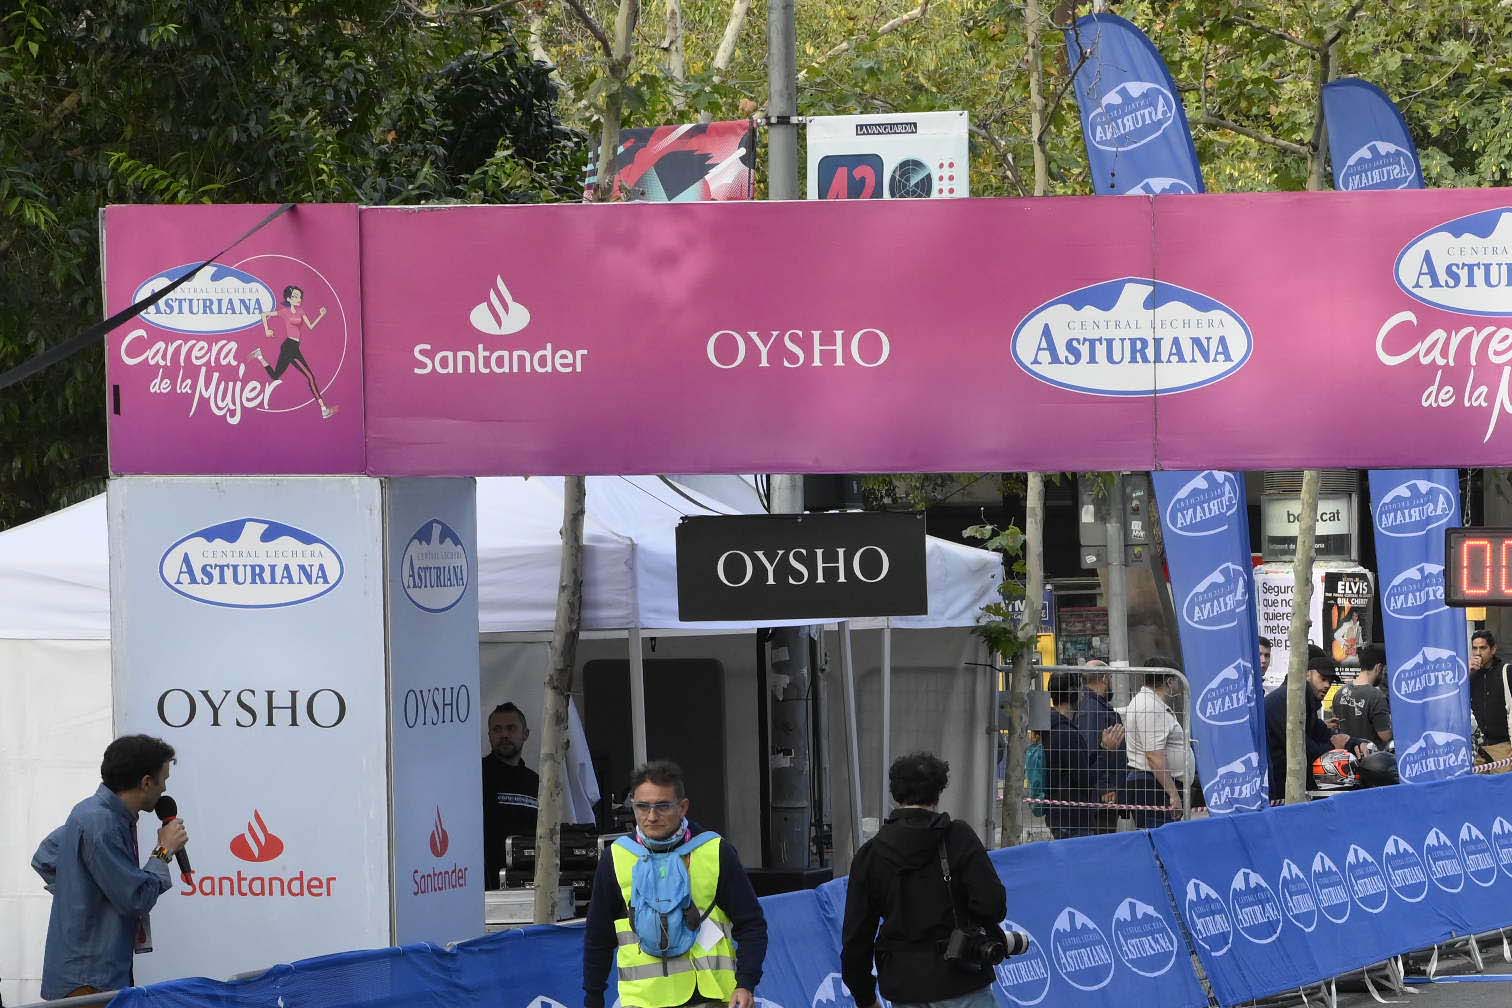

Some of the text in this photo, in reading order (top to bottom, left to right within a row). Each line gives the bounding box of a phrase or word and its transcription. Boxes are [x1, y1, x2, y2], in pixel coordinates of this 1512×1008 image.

[143, 288, 264, 316] ASTURIANA
[214, 287, 260, 295] LECHERA
[1067, 319, 1226, 330] CENTRAL LECHERA
[121, 329, 237, 367] Carrera
[413, 342, 588, 374] Santander
[706, 328, 891, 369] OYSHO
[1030, 323, 1233, 366] ASTURIANA
[150, 364, 282, 425] de la Mujer
[1422, 370, 1455, 408] de
[1464, 367, 1488, 408] la
[174, 552, 330, 585] ASTURIANA
[202, 550, 324, 559] CENTRAL LECHERA
[717, 546, 889, 587] OYSHO
[407, 555, 464, 589] ASTURIANA
[1338, 581, 1368, 594] ELVIS
[1263, 599, 1279, 609] que
[1269, 637, 1283, 648] ste
[157, 688, 346, 728] OYSHO
[404, 684, 470, 728] OYSHO
[412, 862, 468, 897] Santander
[1057, 942, 1111, 974] ASTURIANA
